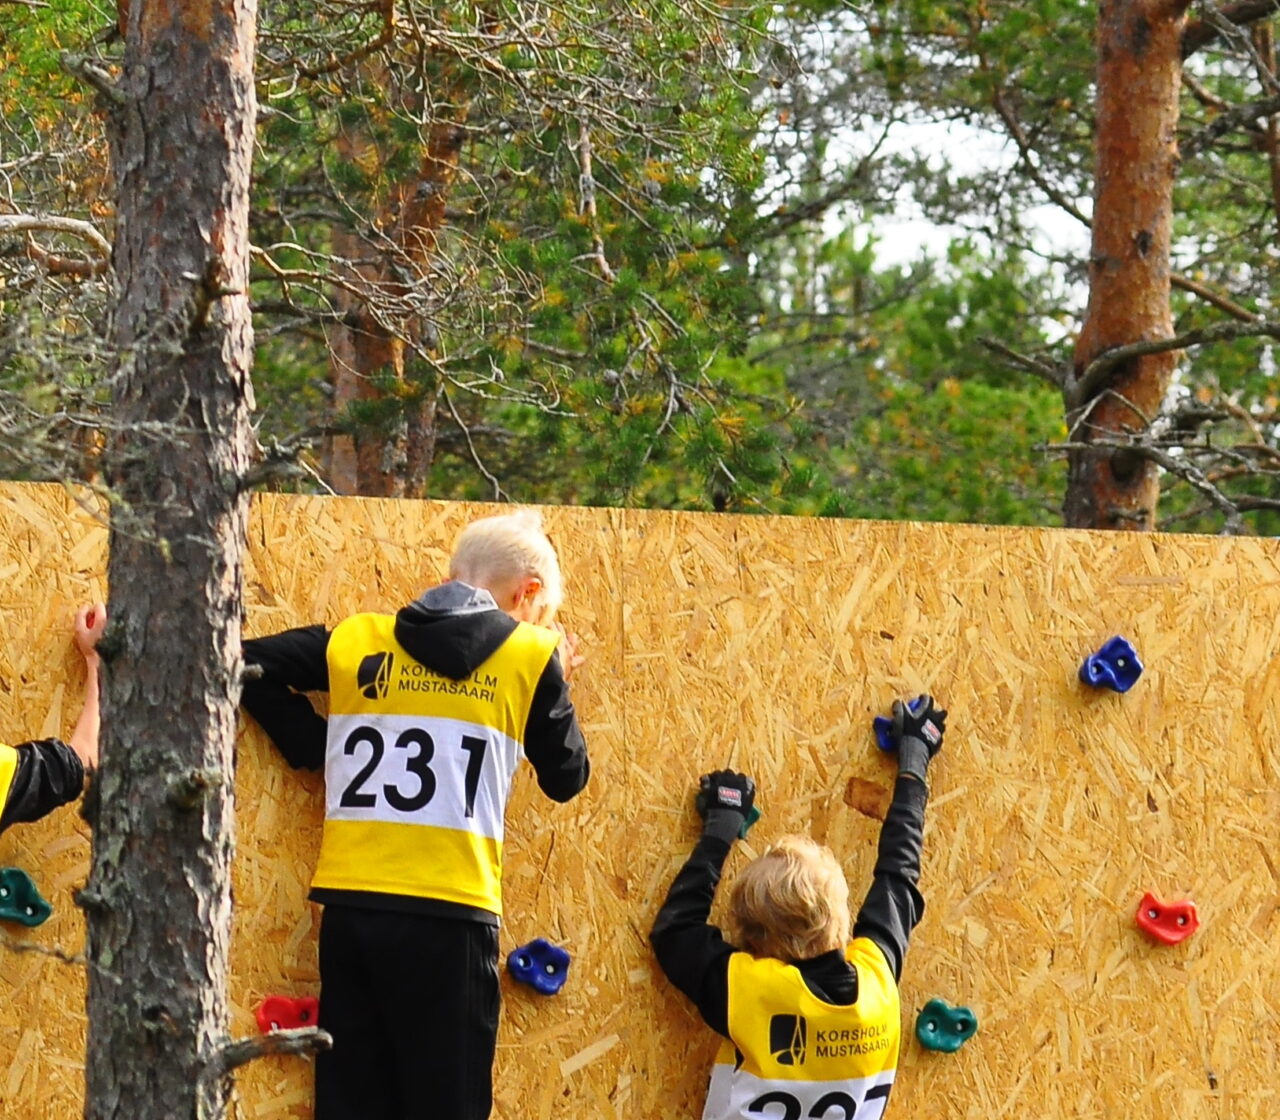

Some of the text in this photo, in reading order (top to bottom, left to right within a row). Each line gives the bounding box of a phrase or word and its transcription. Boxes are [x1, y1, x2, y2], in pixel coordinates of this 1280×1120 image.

[398, 679, 495, 703] MUSTASAARI
[339, 725, 487, 818] 231
[816, 1038, 890, 1057] MUSTASAARI
